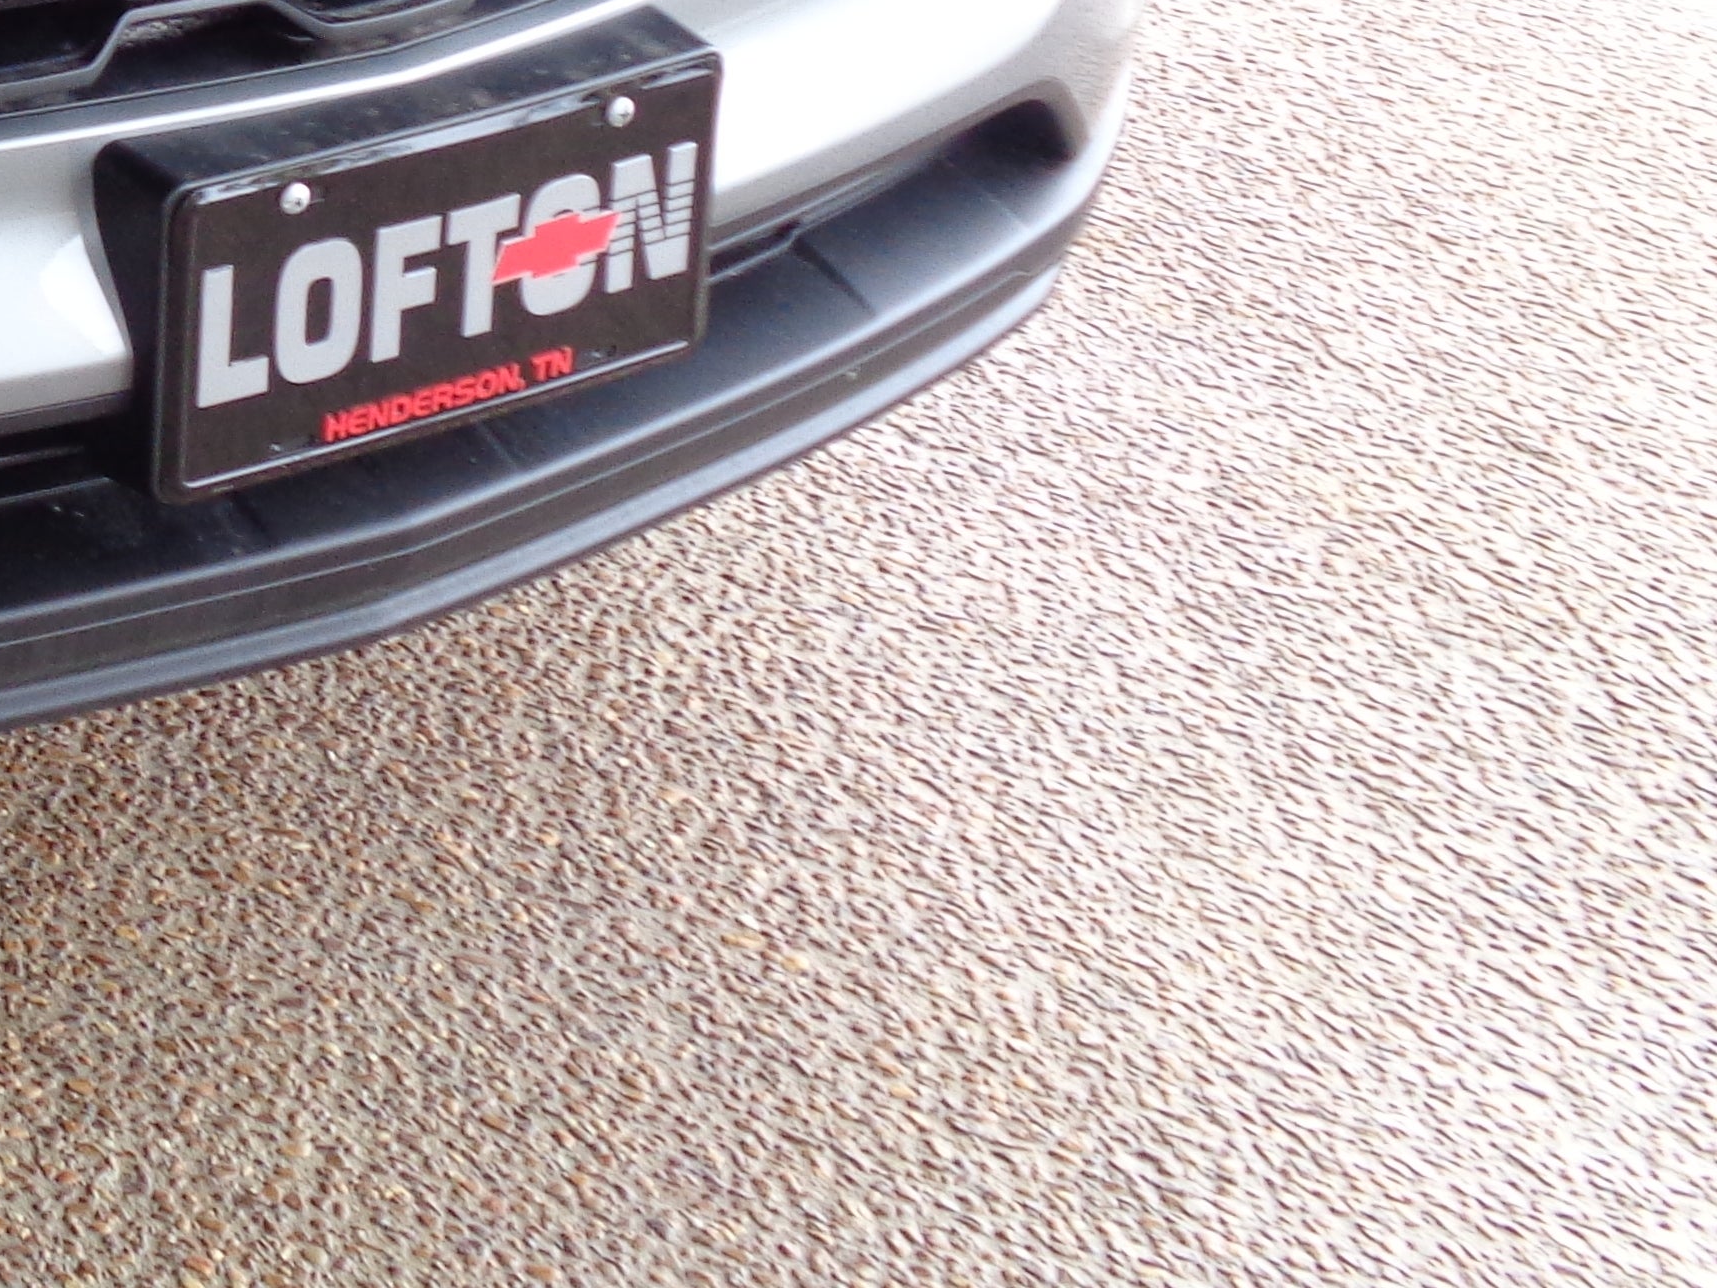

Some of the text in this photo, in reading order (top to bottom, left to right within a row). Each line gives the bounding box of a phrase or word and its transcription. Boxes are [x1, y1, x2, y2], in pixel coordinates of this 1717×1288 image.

[196, 141, 697, 409] LOFTON
[323, 346, 574, 442] HENDERSON, TN
